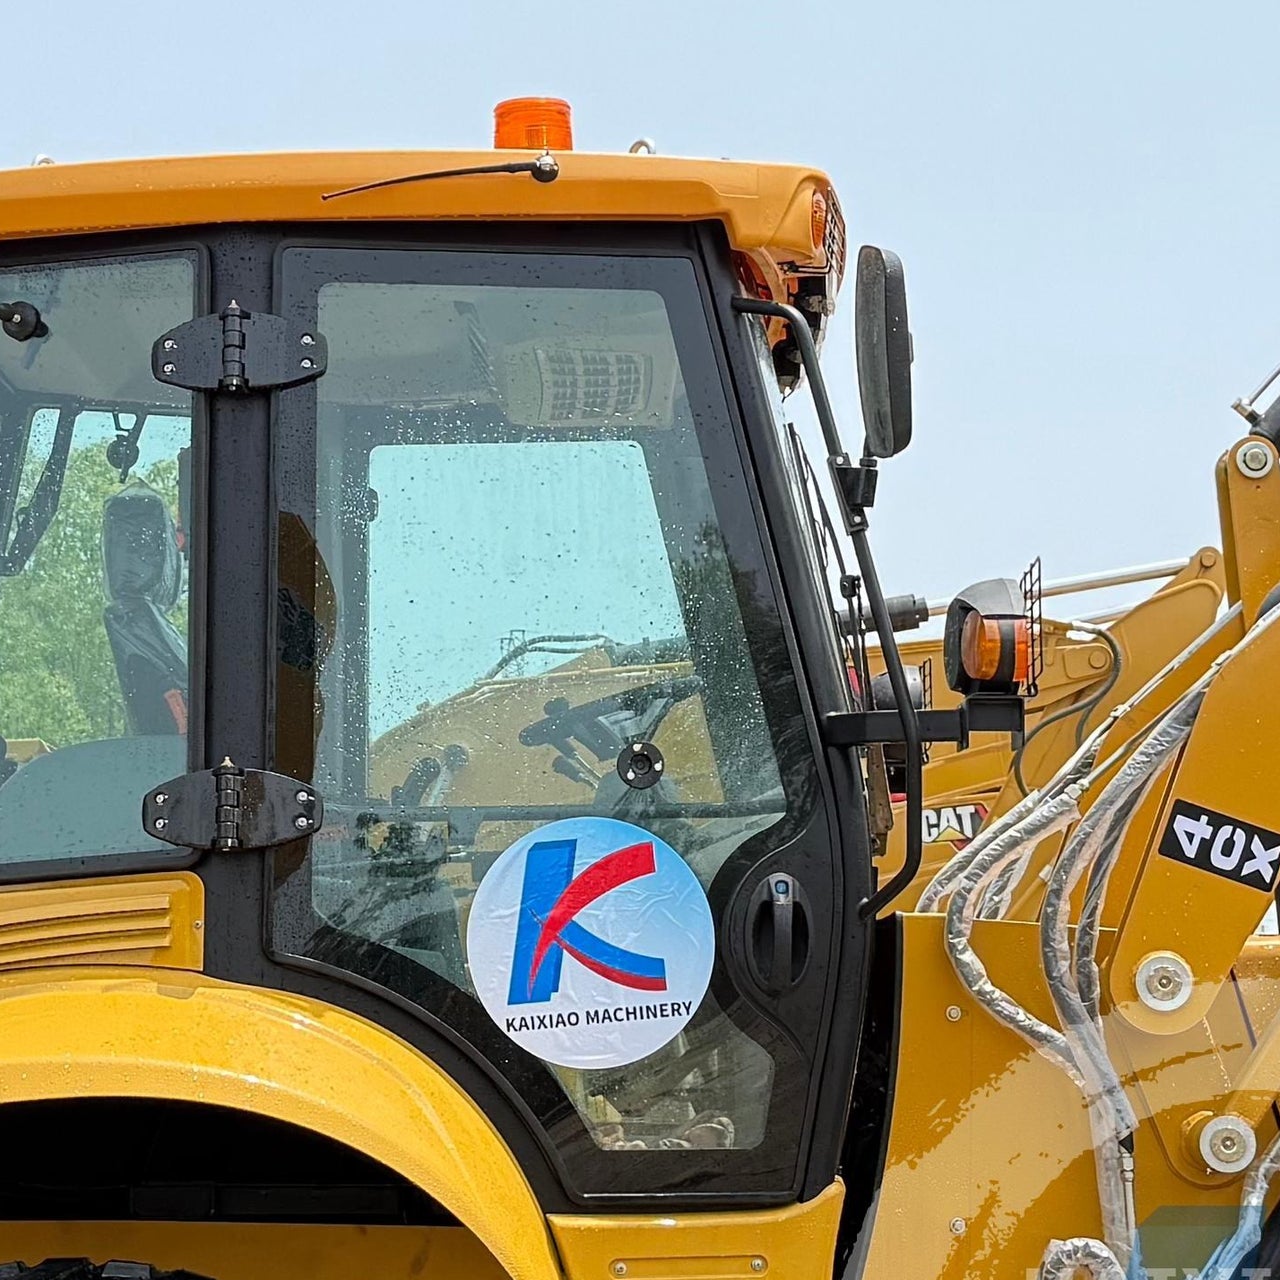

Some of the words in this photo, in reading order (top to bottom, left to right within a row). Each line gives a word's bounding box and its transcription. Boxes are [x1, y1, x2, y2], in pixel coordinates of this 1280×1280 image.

[922, 805, 975, 843] CAT
[506, 1011, 580, 1032] KAIXIAO
[586, 1001, 693, 1025] MACHINERY
